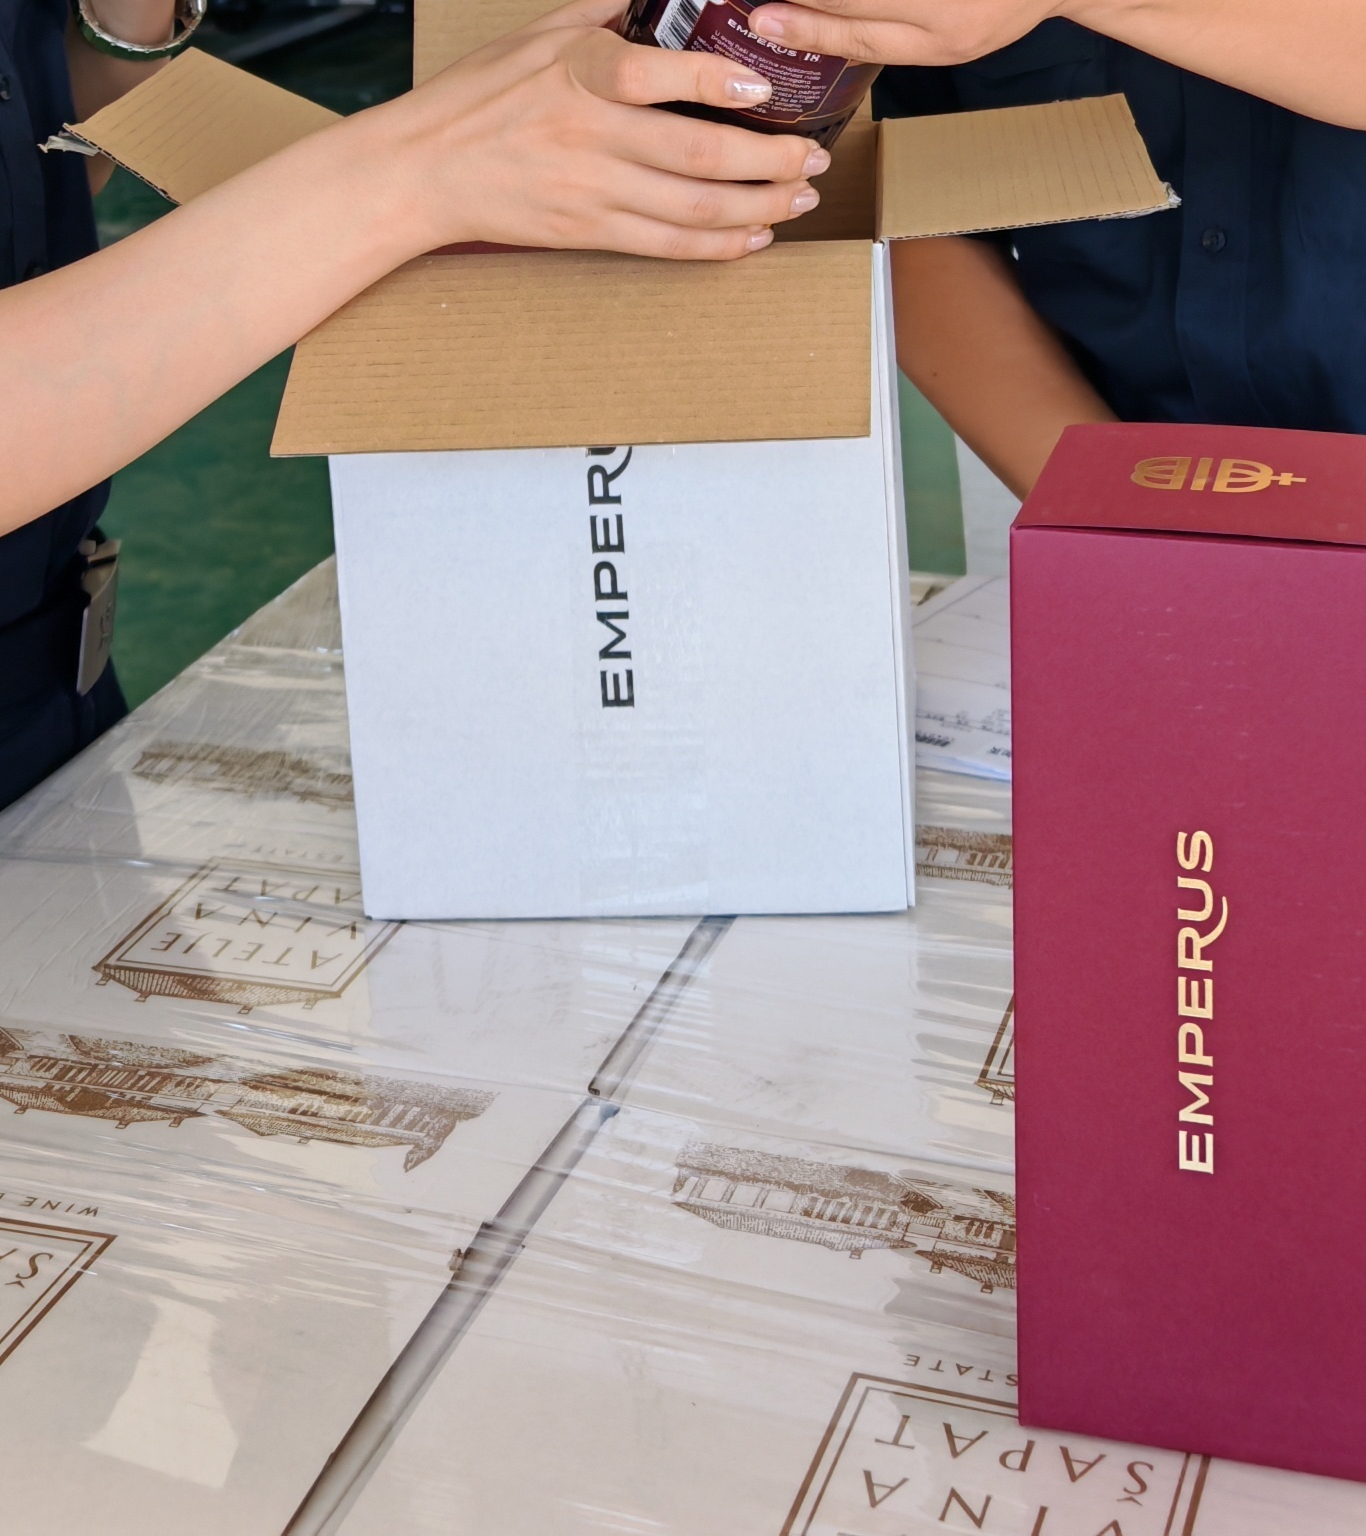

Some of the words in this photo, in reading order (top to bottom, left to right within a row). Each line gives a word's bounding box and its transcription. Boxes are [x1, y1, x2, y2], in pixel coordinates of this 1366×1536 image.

[727, 18, 797, 57] EMPERUS
[802, 52, 821, 63] 18
[584, 446, 635, 709] EMPER
[210, 876, 363, 905] APAT
[194, 902, 358, 940] VINA
[150, 931, 344, 970] ATELJE
[1177, 829, 1228, 1175] EMPERUS
[20, 1196, 99, 1217] WINE
[903, 1353, 1019, 1387] STATE
[874, 1414, 1154, 1506] ŠAPAT
